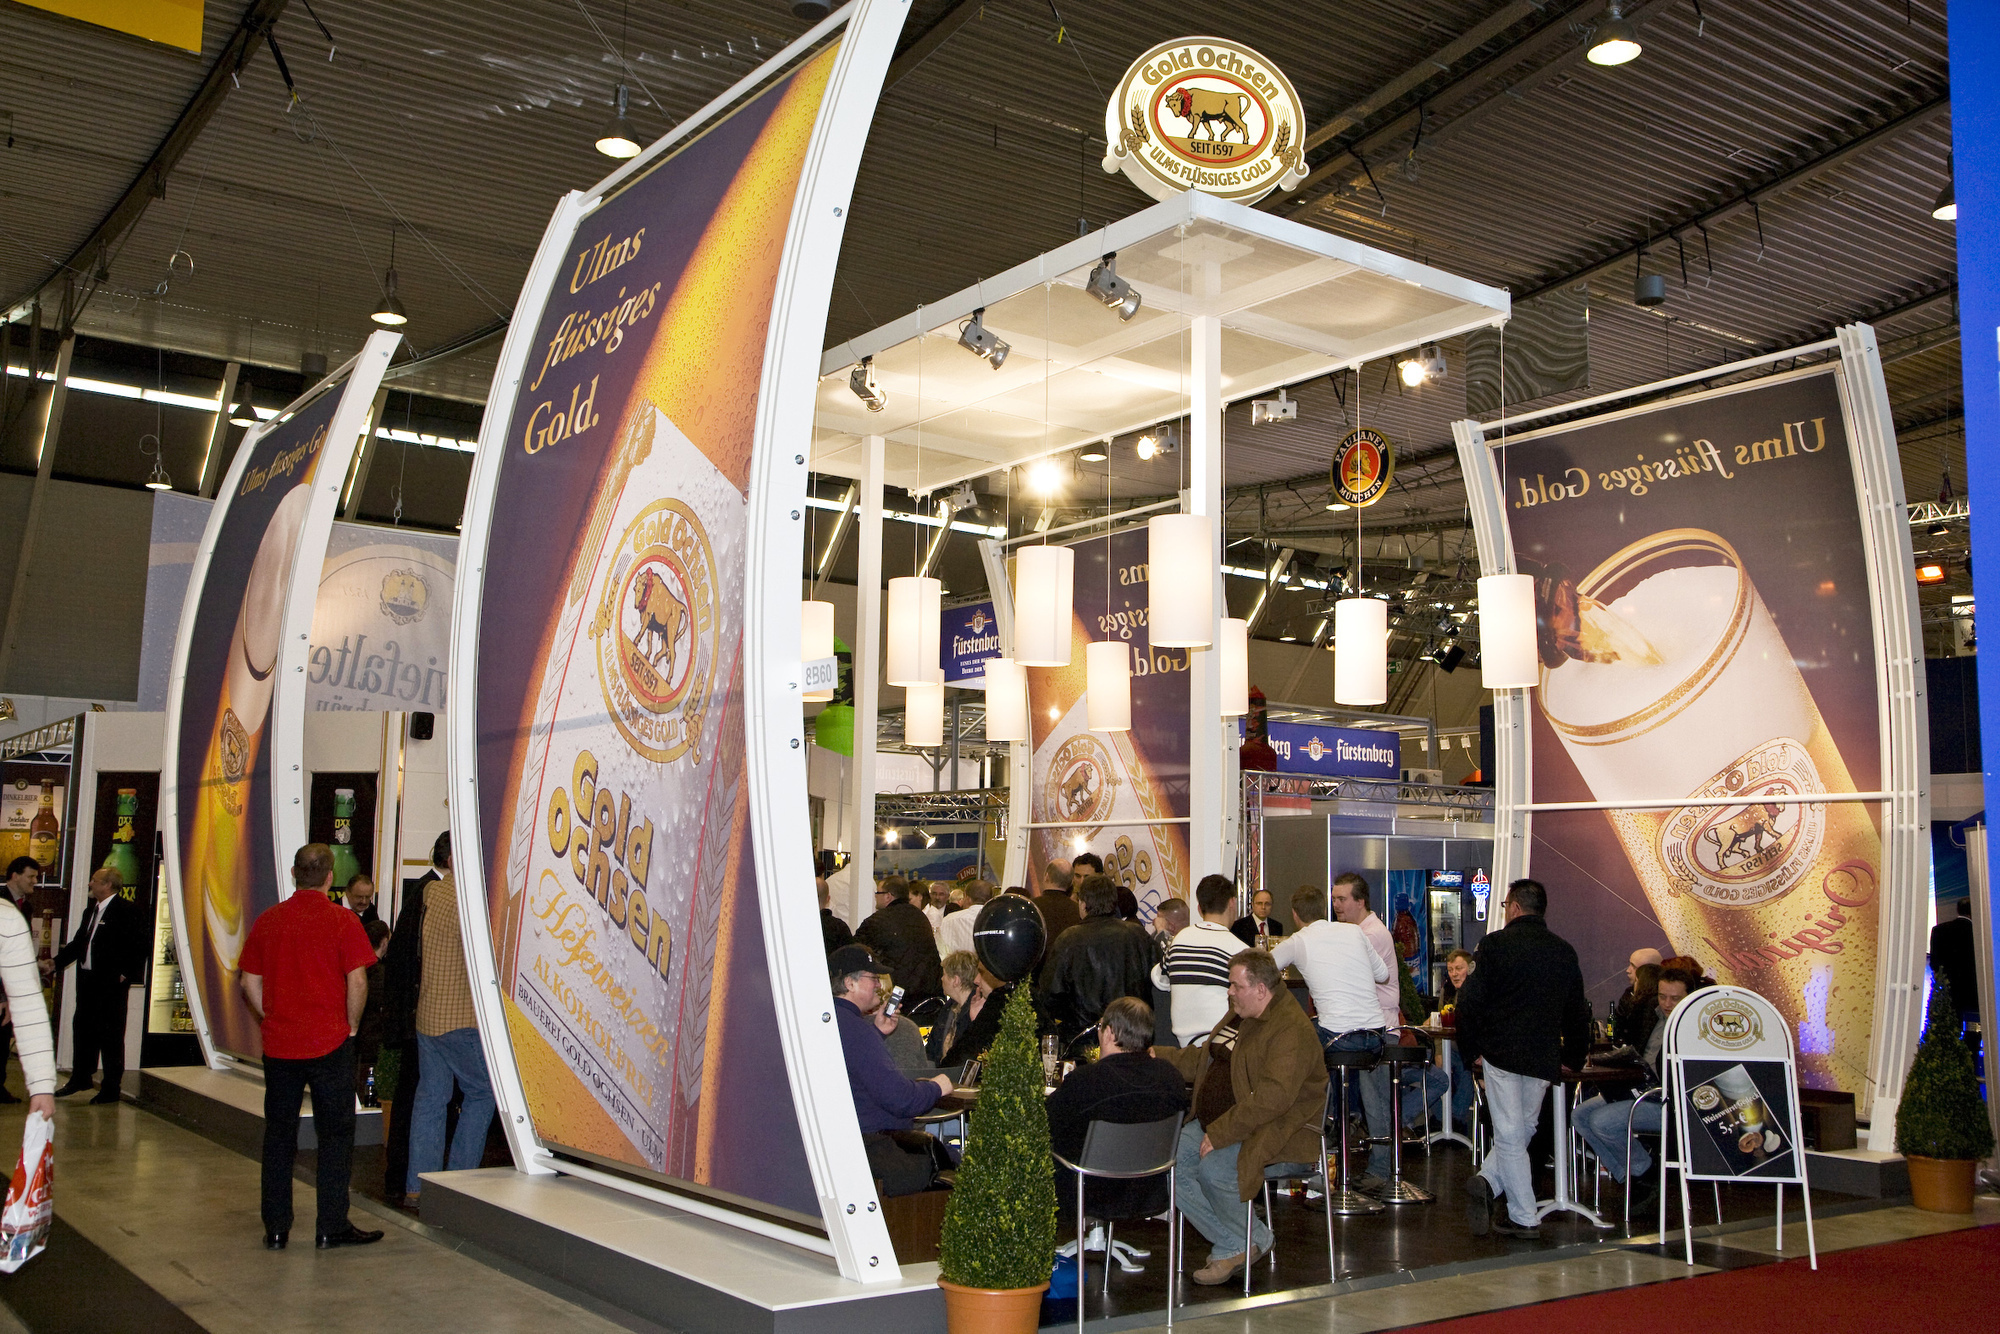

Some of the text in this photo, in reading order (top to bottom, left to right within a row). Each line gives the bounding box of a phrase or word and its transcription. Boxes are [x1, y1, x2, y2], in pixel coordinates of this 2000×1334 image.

[1141, 46, 1279, 101] Gold Ochsen
[1149, 146, 1272, 187] ULMS FLÜSSIGES GOLD
[1190, 141, 1234, 157] SEIT 1597
[569, 227, 646, 295] Ulms
[530, 281, 662, 392] flüssiges
[524, 374, 600, 455] Gold.
[240, 466, 268, 496] Ulms
[309, 424, 326, 454] Go
[1335, 431, 1386, 463] PAULANER
[1338, 479, 1382, 502] MÜNCHEN
[633, 511, 713, 634] Gold Ochsen
[805, 663, 833, 686] 8B60
[654, 720, 679, 743] GOLD
[1336, 737, 1395, 769] Fürstenberg
[117, 815, 133, 827] OXX
[334, 818, 351, 829] OXX
[572, 749, 654, 895] Gold
[119, 885, 136, 903] XX
[547, 786, 672, 985] Ochsen
[1440, 873, 1463, 883] PEPSI
[1471, 883, 1490, 892] PEPSI
[530, 868, 670, 1068] Hefeweizen
[533, 953, 653, 1108] ALKOHOLFREI
[518, 984, 664, 1166] BRAUEREI GOLD OCHSEN ULM
